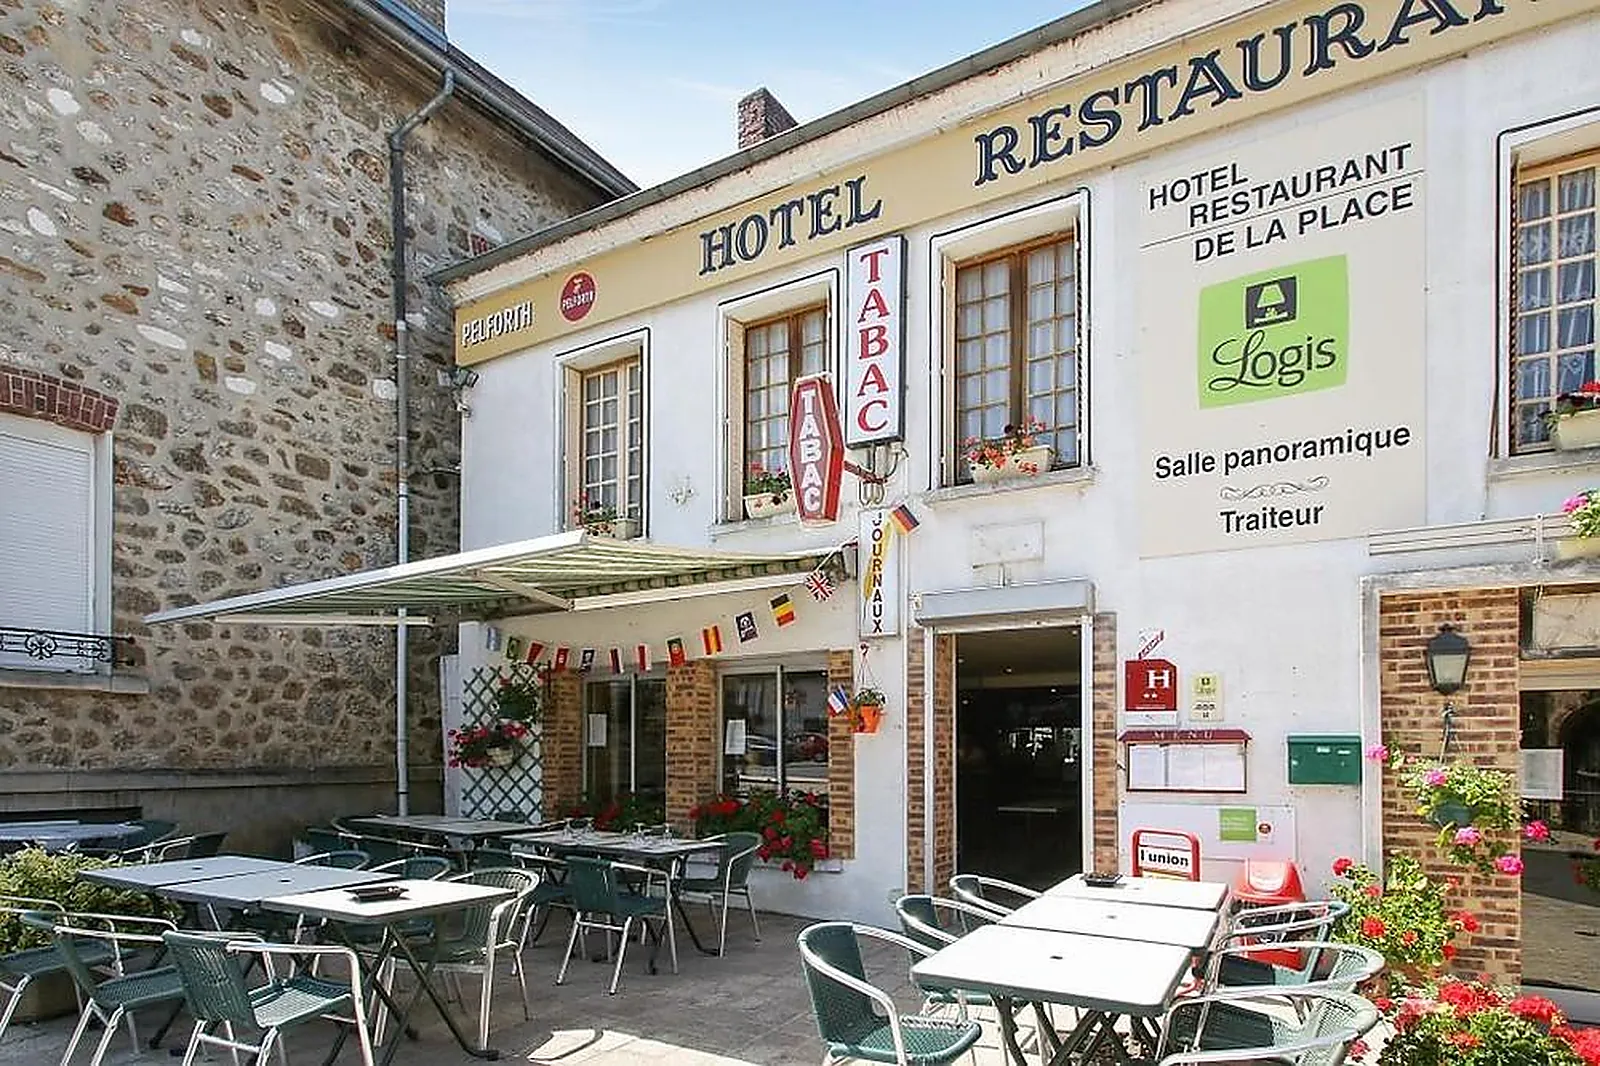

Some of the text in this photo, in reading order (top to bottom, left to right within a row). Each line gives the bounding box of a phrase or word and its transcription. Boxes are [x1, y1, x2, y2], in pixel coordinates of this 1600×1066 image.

[1149, 162, 1249, 211] HOTEL
[1189, 143, 1412, 227] RESTAURANT
[699, 175, 882, 275] HOTEL
[1195, 183, 1414, 262] DE LA PLACE
[461, 300, 533, 348] PELFORTH
[857, 247, 891, 433] TABAC
[1208, 329, 1337, 391] Logis
[799, 388, 823, 513] TABAC
[1155, 425, 1411, 480] Salle panoramique
[1220, 504, 1325, 534] Traiteur
[871, 511, 884, 634] JOURNAUX
[1147, 669, 1170, 690] H
